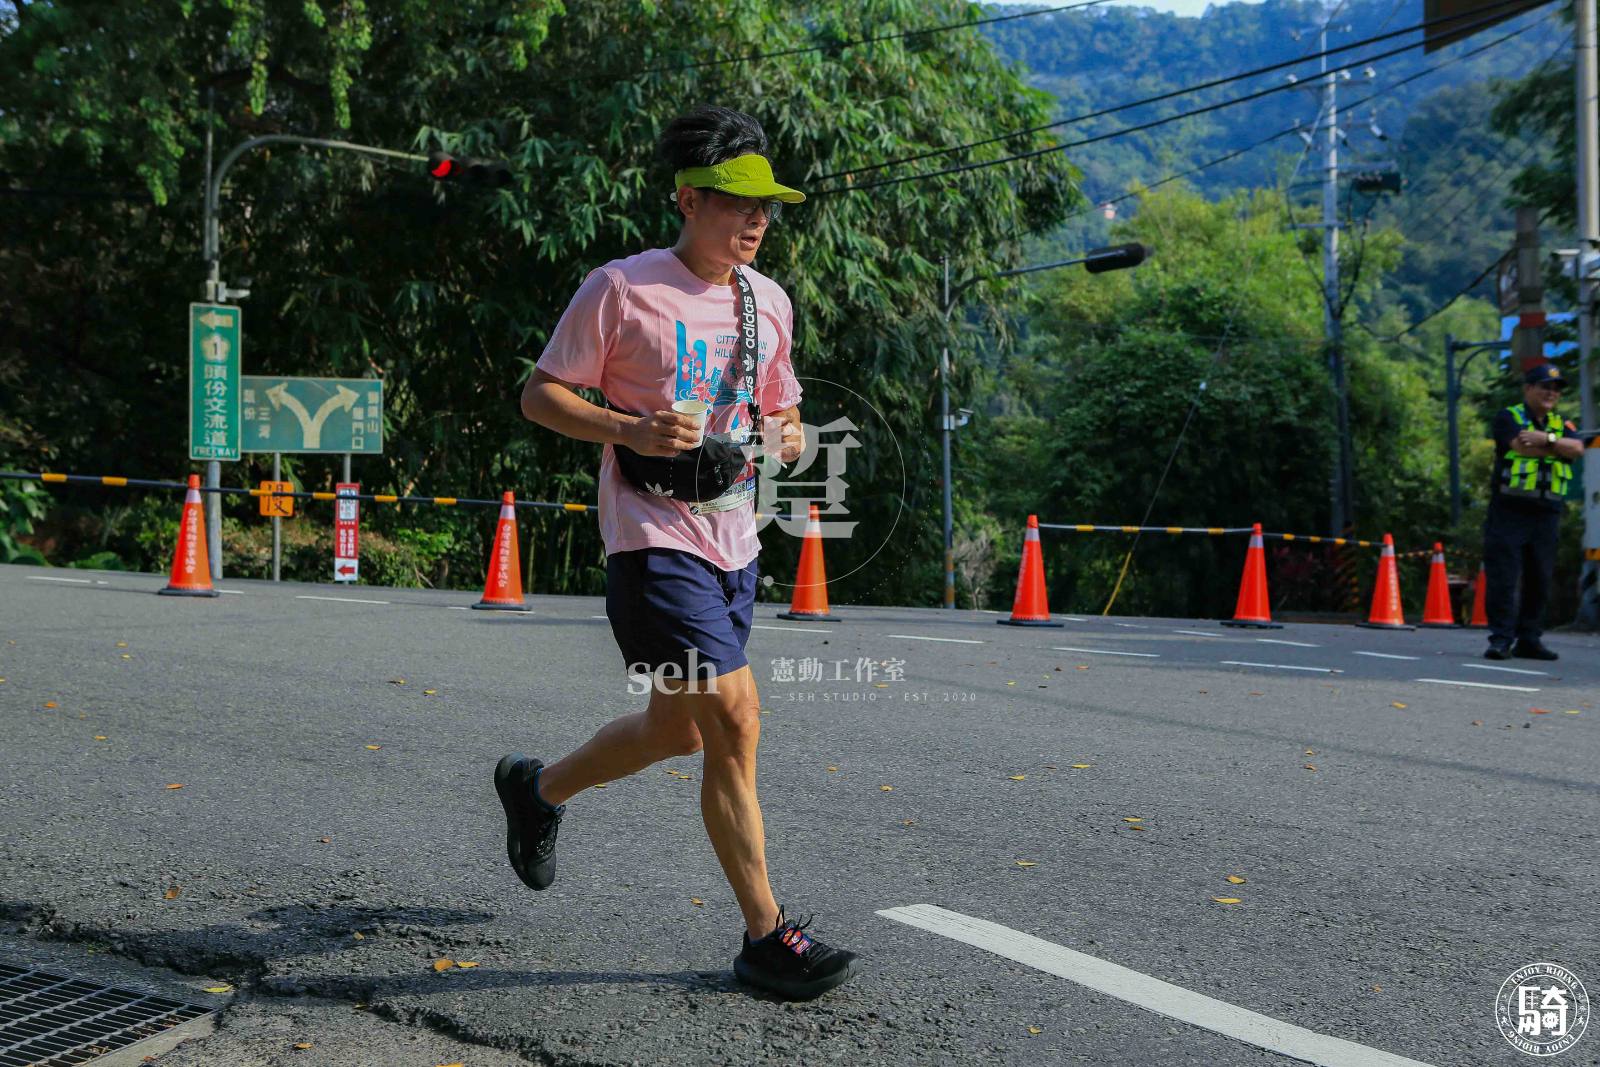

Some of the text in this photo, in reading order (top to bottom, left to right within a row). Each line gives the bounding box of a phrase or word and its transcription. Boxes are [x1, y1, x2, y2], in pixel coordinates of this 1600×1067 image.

[741, 295, 756, 349] adidas
[204, 364, 228, 446] 頭份交流道
[193, 446, 237, 458] FREEWAY
